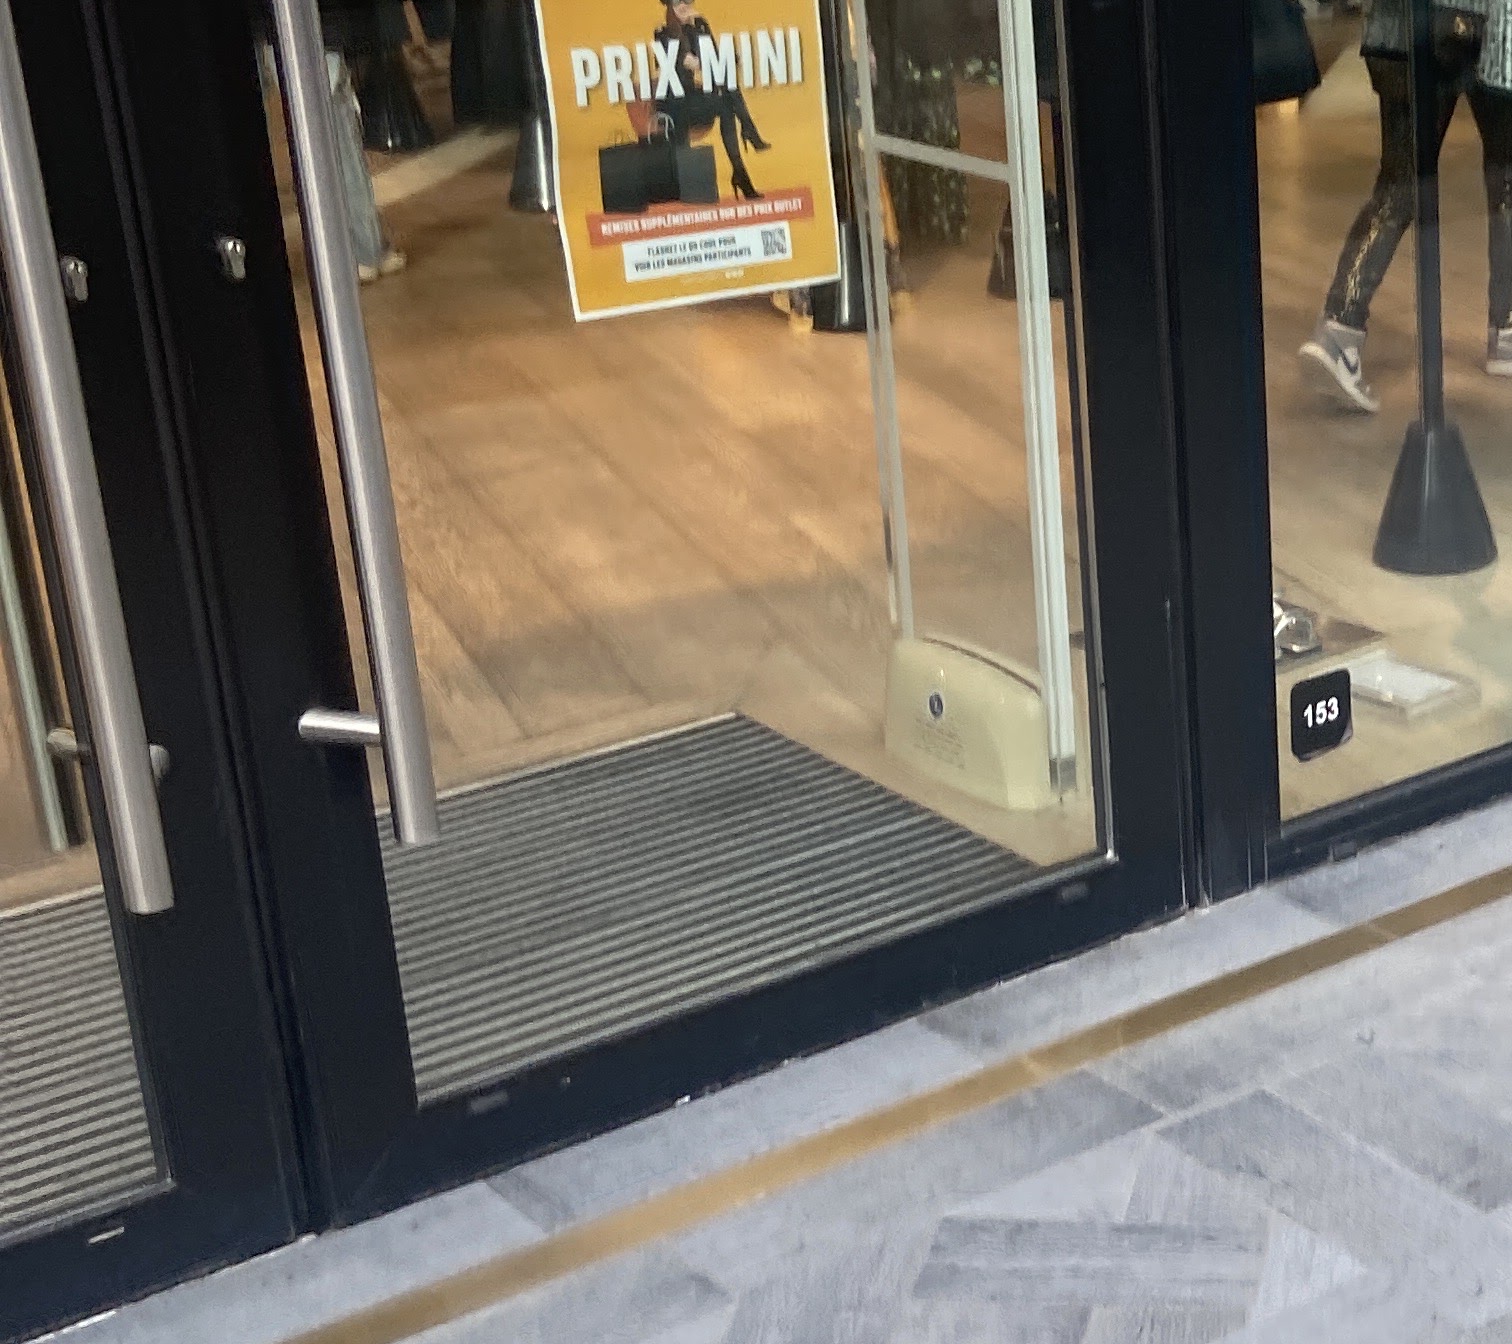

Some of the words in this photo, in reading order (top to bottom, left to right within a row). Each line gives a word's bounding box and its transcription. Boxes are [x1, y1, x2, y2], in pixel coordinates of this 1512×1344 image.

[570, 36, 686, 107] PRIX
[699, 26, 804, 92] MINI
[1303, 696, 1339, 728] 153
